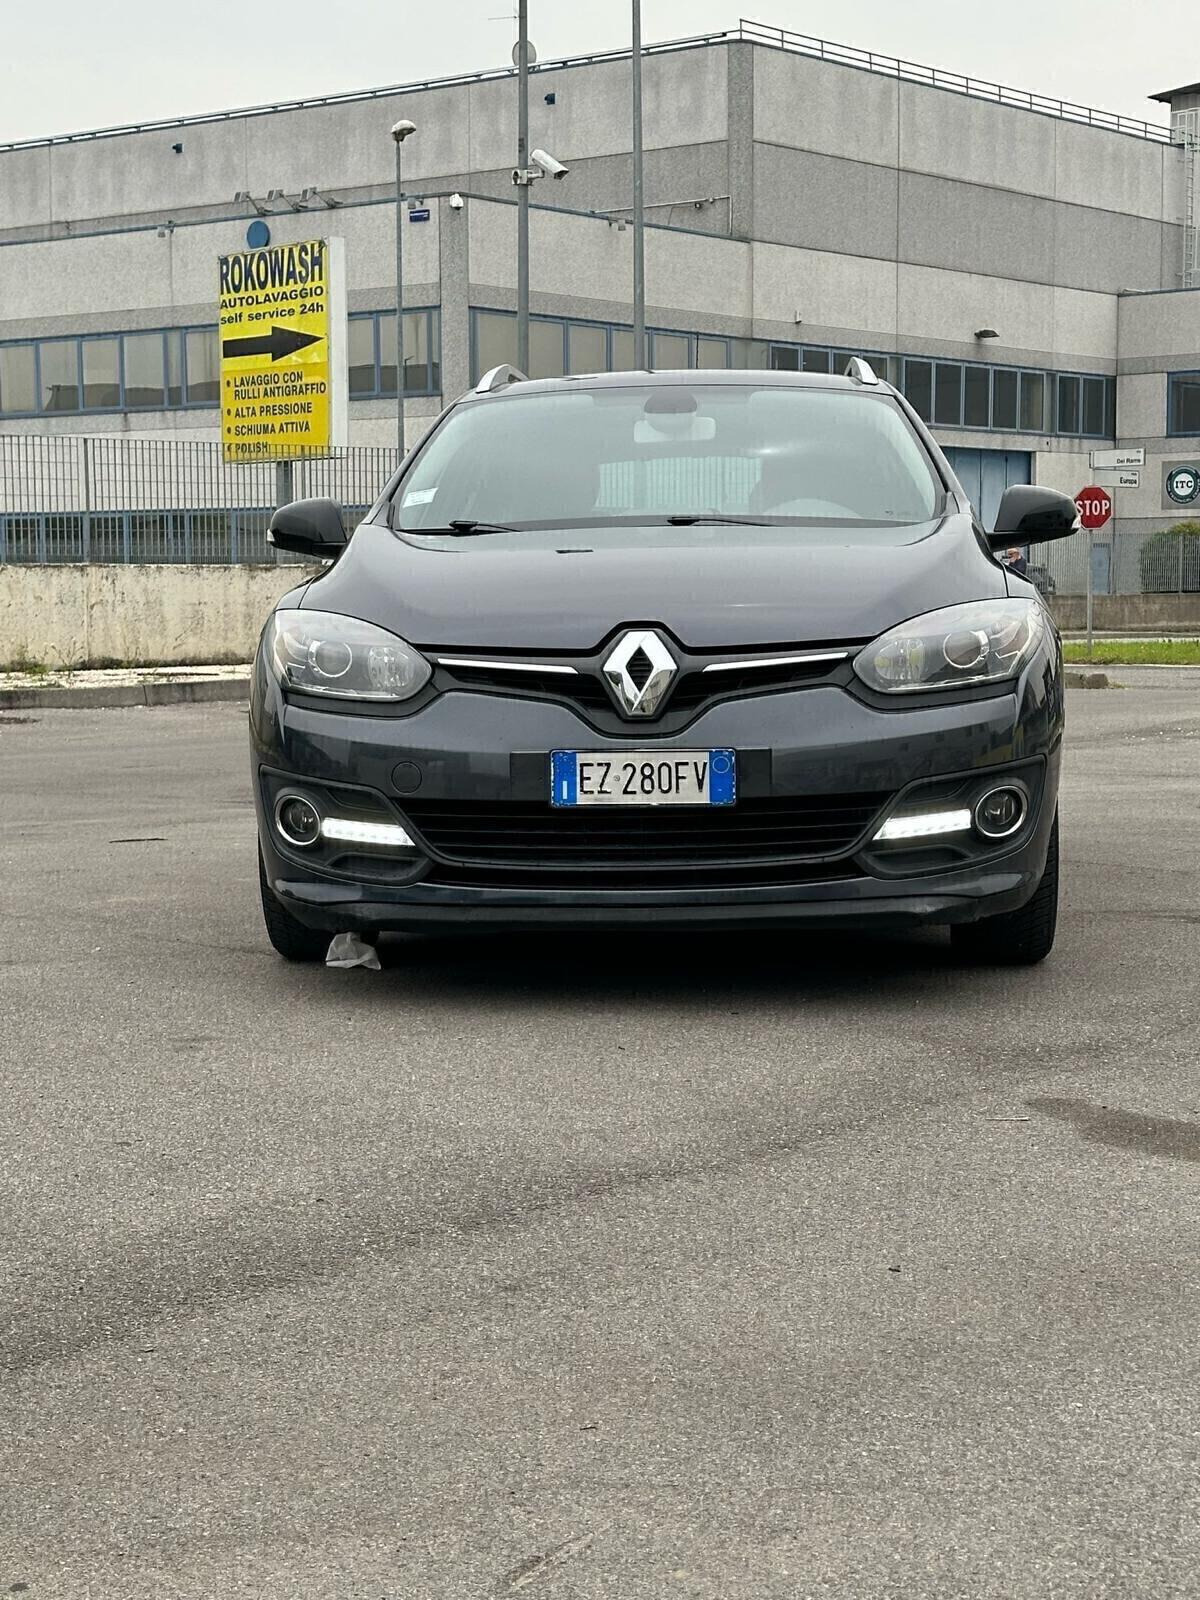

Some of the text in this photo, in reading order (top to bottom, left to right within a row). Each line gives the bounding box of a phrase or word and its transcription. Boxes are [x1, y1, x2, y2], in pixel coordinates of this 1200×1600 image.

[220, 243, 323, 295] ROKOWASH
[220, 286, 324, 309] AUTOLAVAGGIO
[220, 302, 324, 325] self service 24h
[234, 371, 303, 387] LAVAGGIO CON
[234, 382, 326, 400] RULLI ANTIGRAFFIO
[235, 402, 312, 418] ALTA PRESSIONE
[235, 420, 310, 436] SCHIUMA ATTIVA
[1075, 500, 1110, 516] STOP
[579, 762, 708, 795] EZ 280FV
